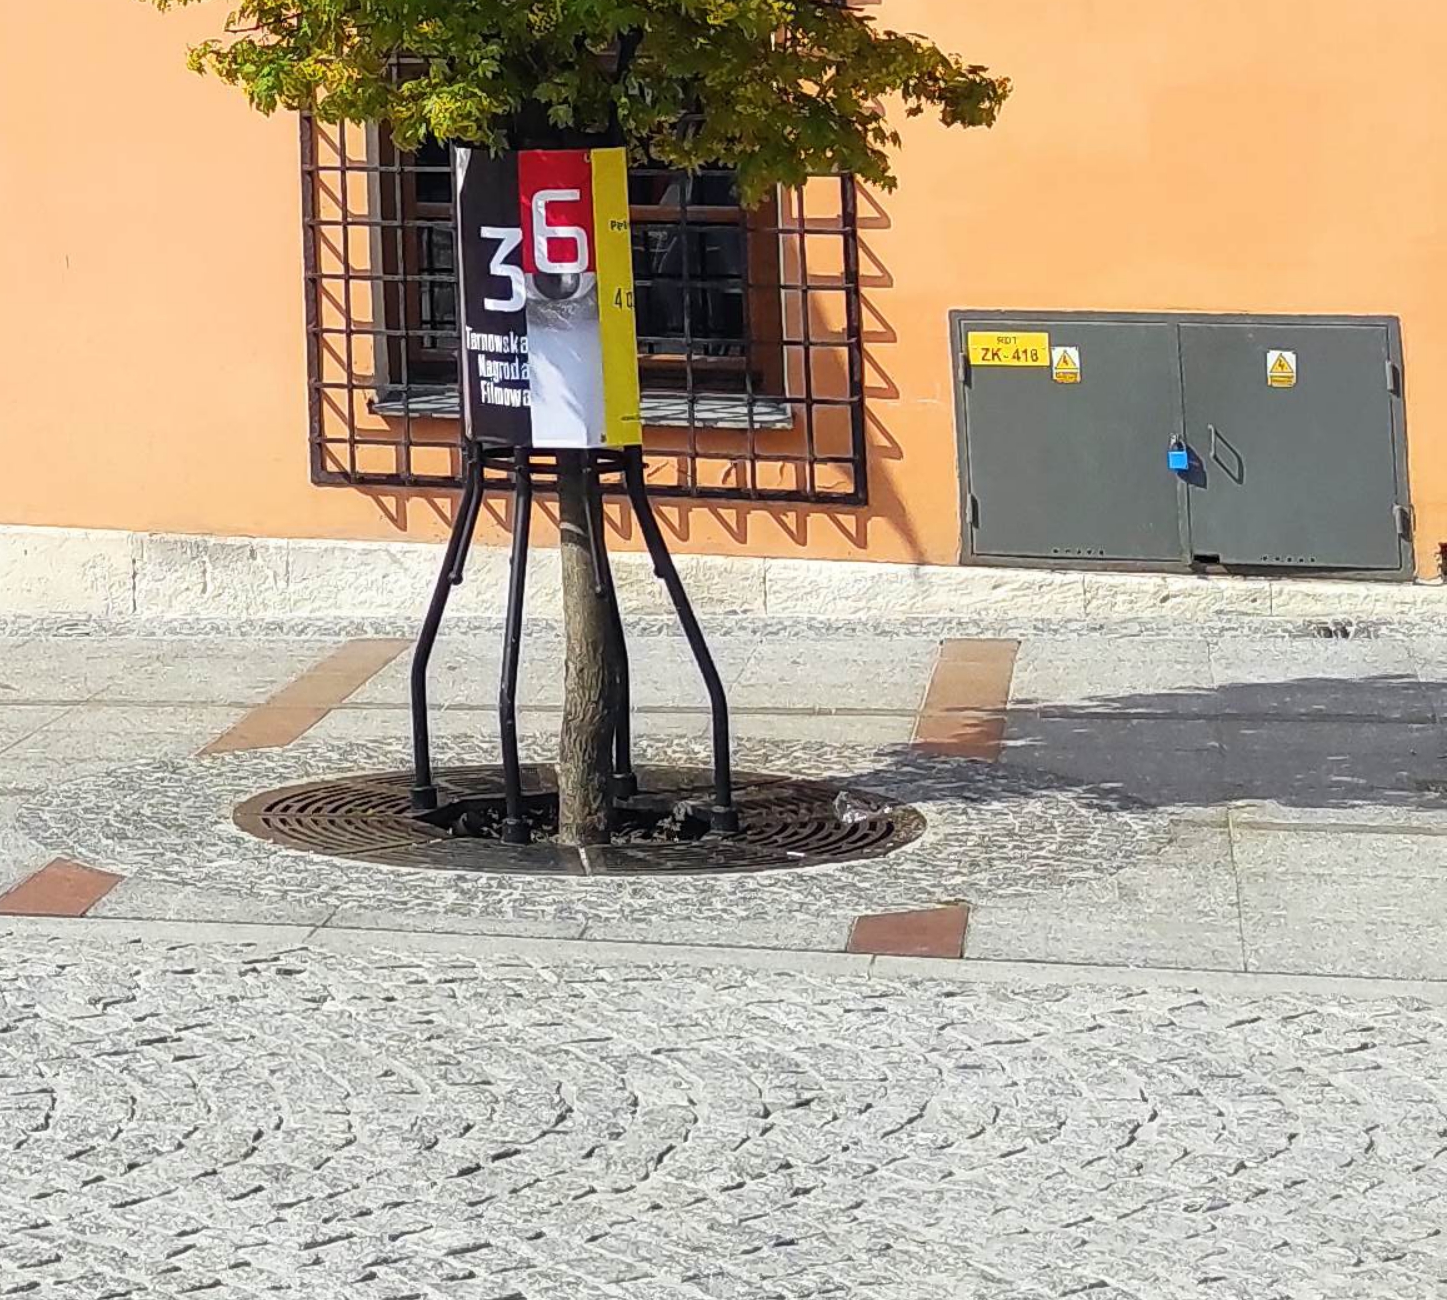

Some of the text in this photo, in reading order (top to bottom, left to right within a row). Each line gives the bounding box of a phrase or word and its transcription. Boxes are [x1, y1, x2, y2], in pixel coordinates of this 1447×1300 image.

[480, 189, 589, 313] 36
[465, 325, 528, 354] Tarnowska
[478, 353, 530, 383] Nagroda
[480, 380, 532, 408] Filmowa
